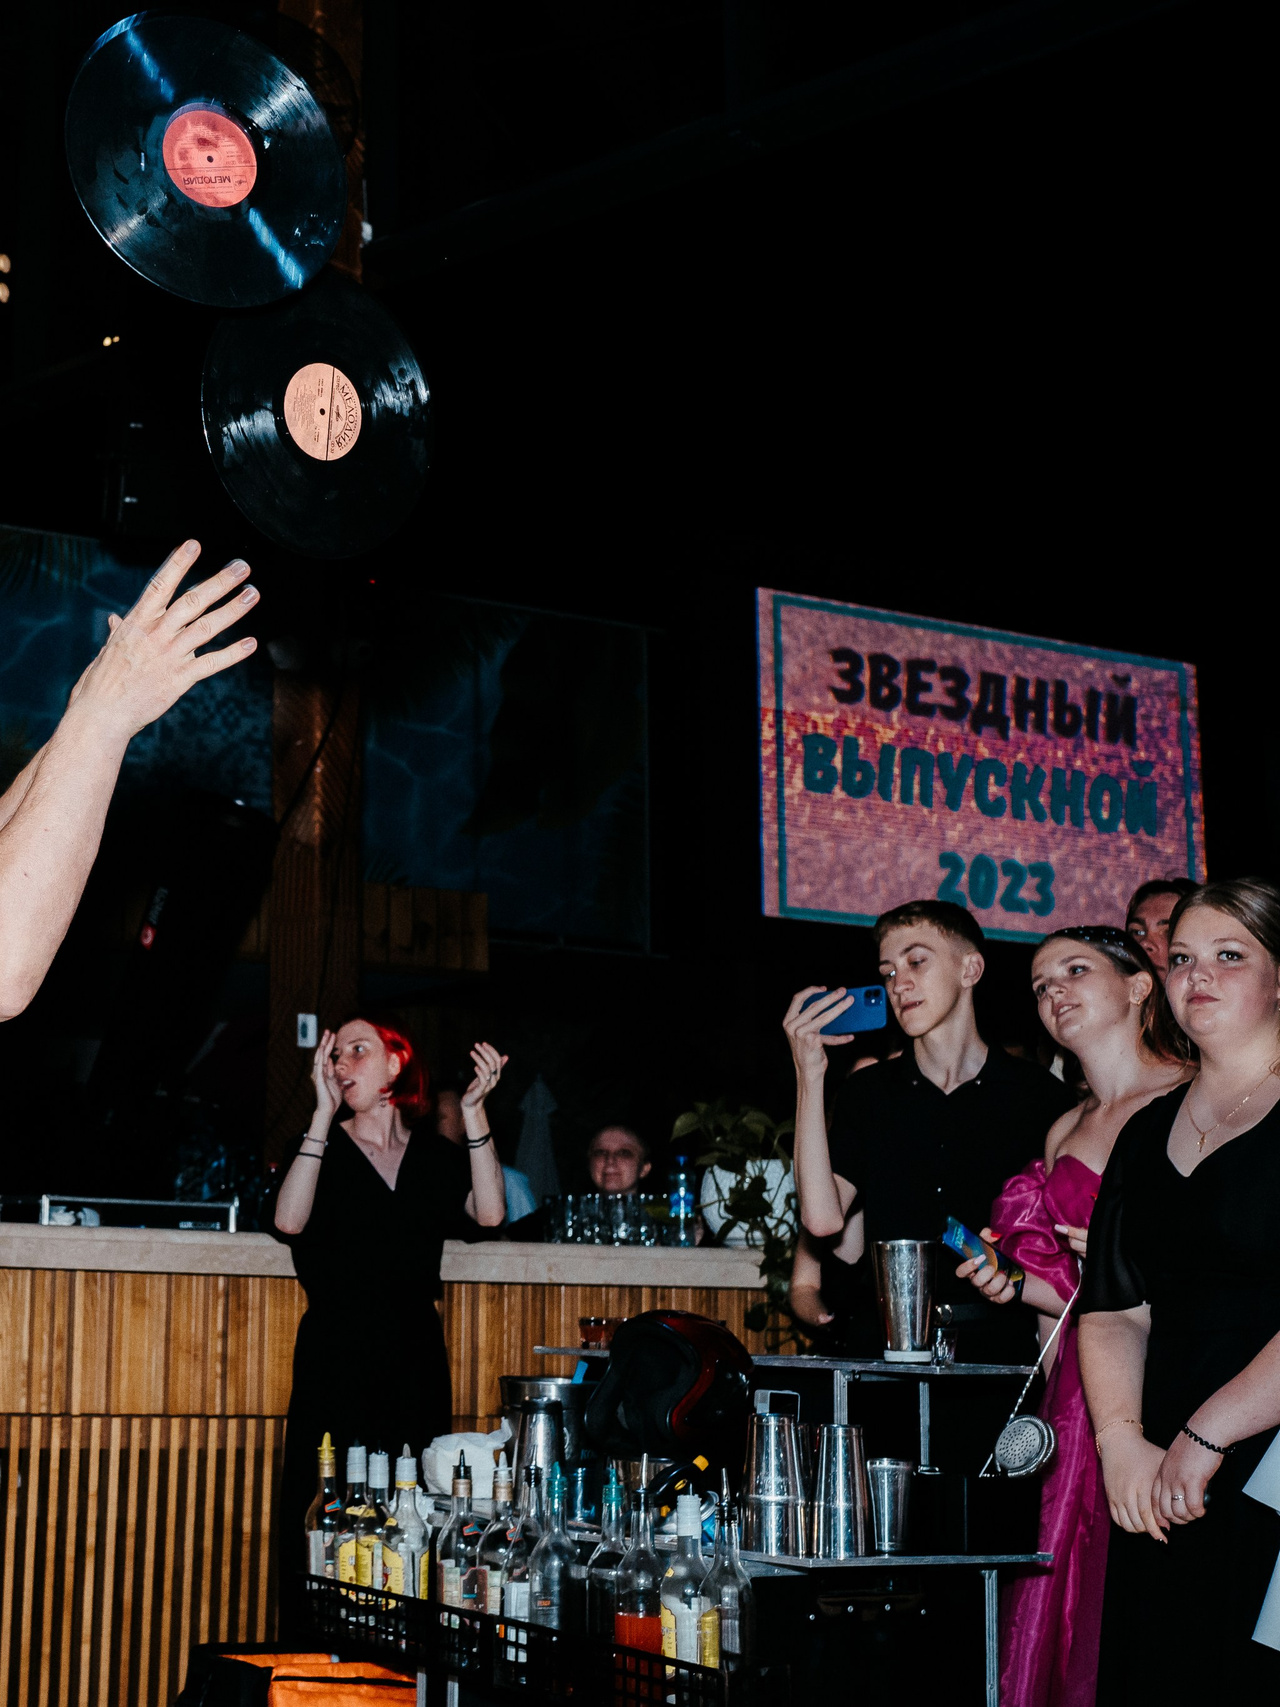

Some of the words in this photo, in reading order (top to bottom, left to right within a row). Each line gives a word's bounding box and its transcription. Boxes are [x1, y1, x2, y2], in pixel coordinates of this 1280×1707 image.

[183, 175, 231, 186] МЕЛОДИЯ
[335, 385, 356, 448] МЕЛОДИЯ
[828, 647, 1138, 750] ЗВЕЗДНЫЙ
[802, 733, 1158, 837] ВЫПУСКНОЙ
[937, 851, 1056, 917] 2023
